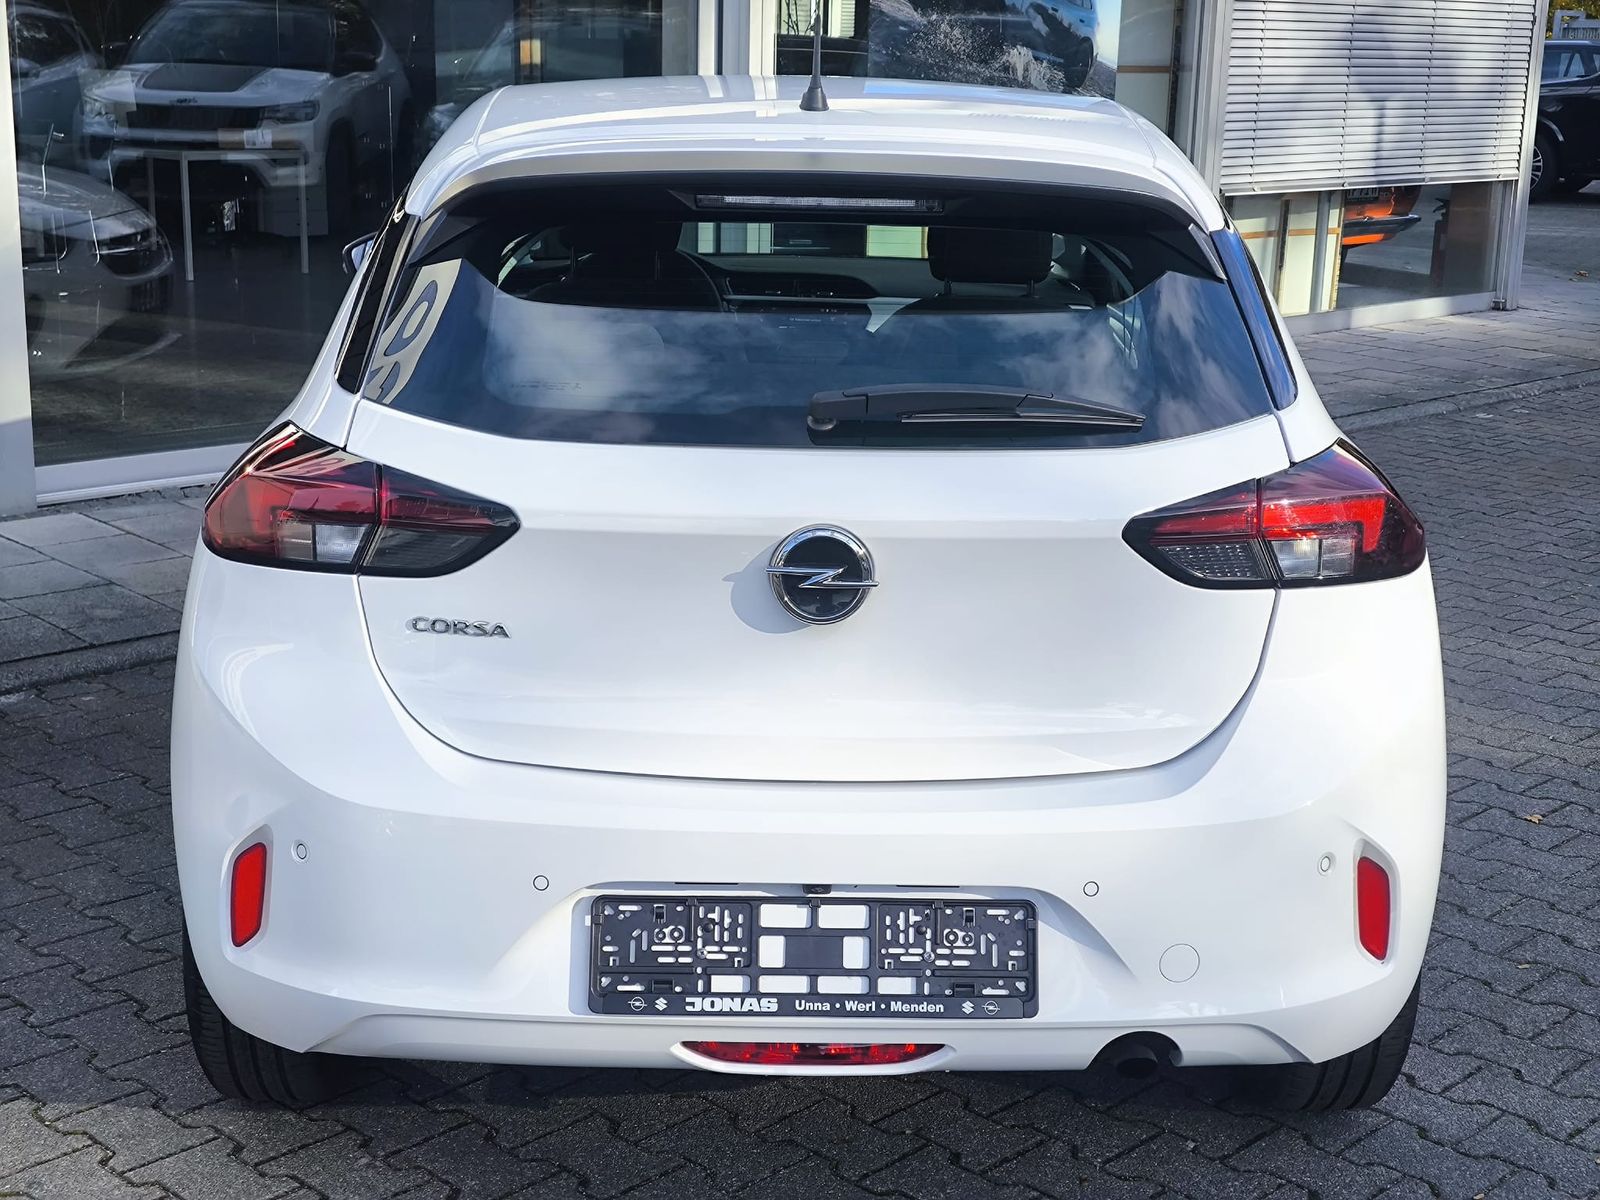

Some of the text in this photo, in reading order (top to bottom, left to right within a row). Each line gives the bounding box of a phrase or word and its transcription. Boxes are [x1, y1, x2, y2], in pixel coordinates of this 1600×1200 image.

[406, 616, 510, 638] CORSA
[685, 997, 944, 1012] JONAS Unna Werl Menden
